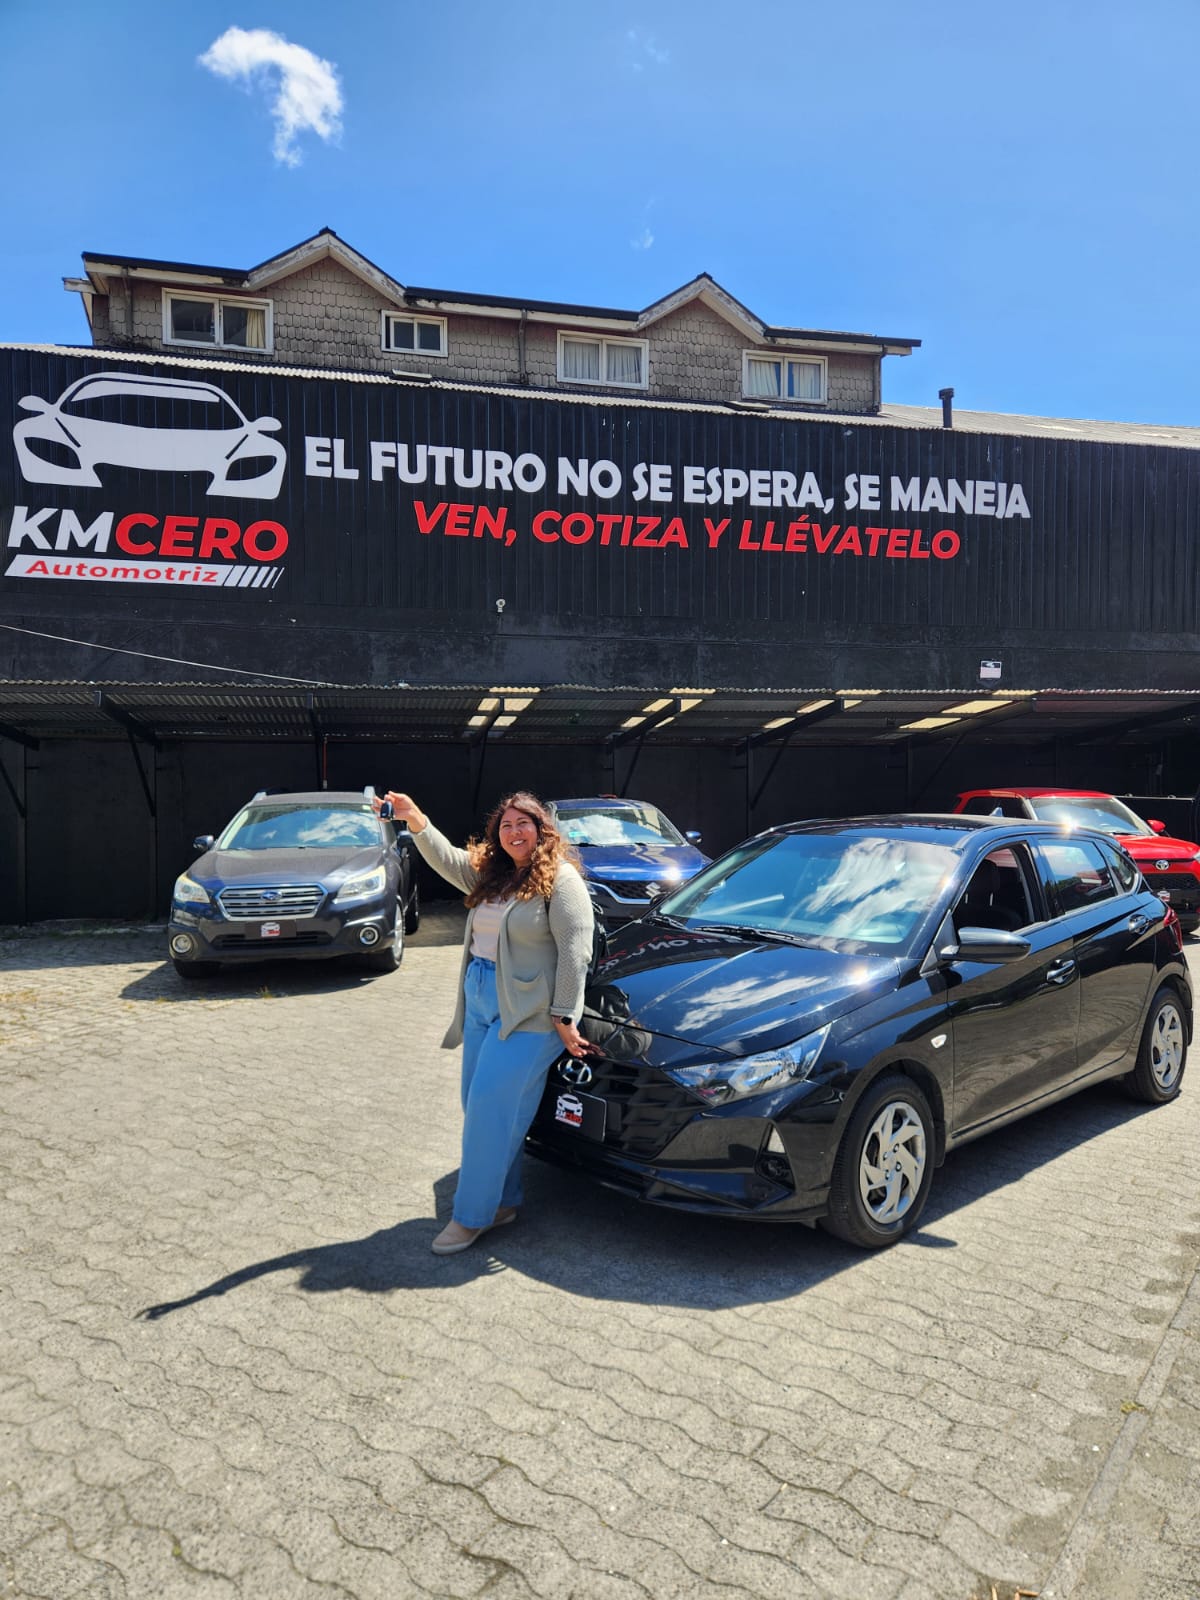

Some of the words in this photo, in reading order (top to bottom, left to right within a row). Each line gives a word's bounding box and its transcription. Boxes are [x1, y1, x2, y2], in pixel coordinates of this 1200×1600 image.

[304, 435, 360, 480] EL
[370, 441, 547, 493] FUTURO
[557, 456, 622, 499] NO
[631, 462, 673, 503] SE
[683, 465, 835, 514] ESPERA,
[844, 473, 881, 512] SE
[890, 475, 1031, 519] MANEJA
[7, 505, 289, 562] KMCERO
[413, 500, 517, 547] VEN,
[532, 510, 689, 549] COTIZA
[704, 518, 731, 549] Y
[738, 514, 961, 560] LLÉVATELO
[26, 560, 218, 583] Automotriz
